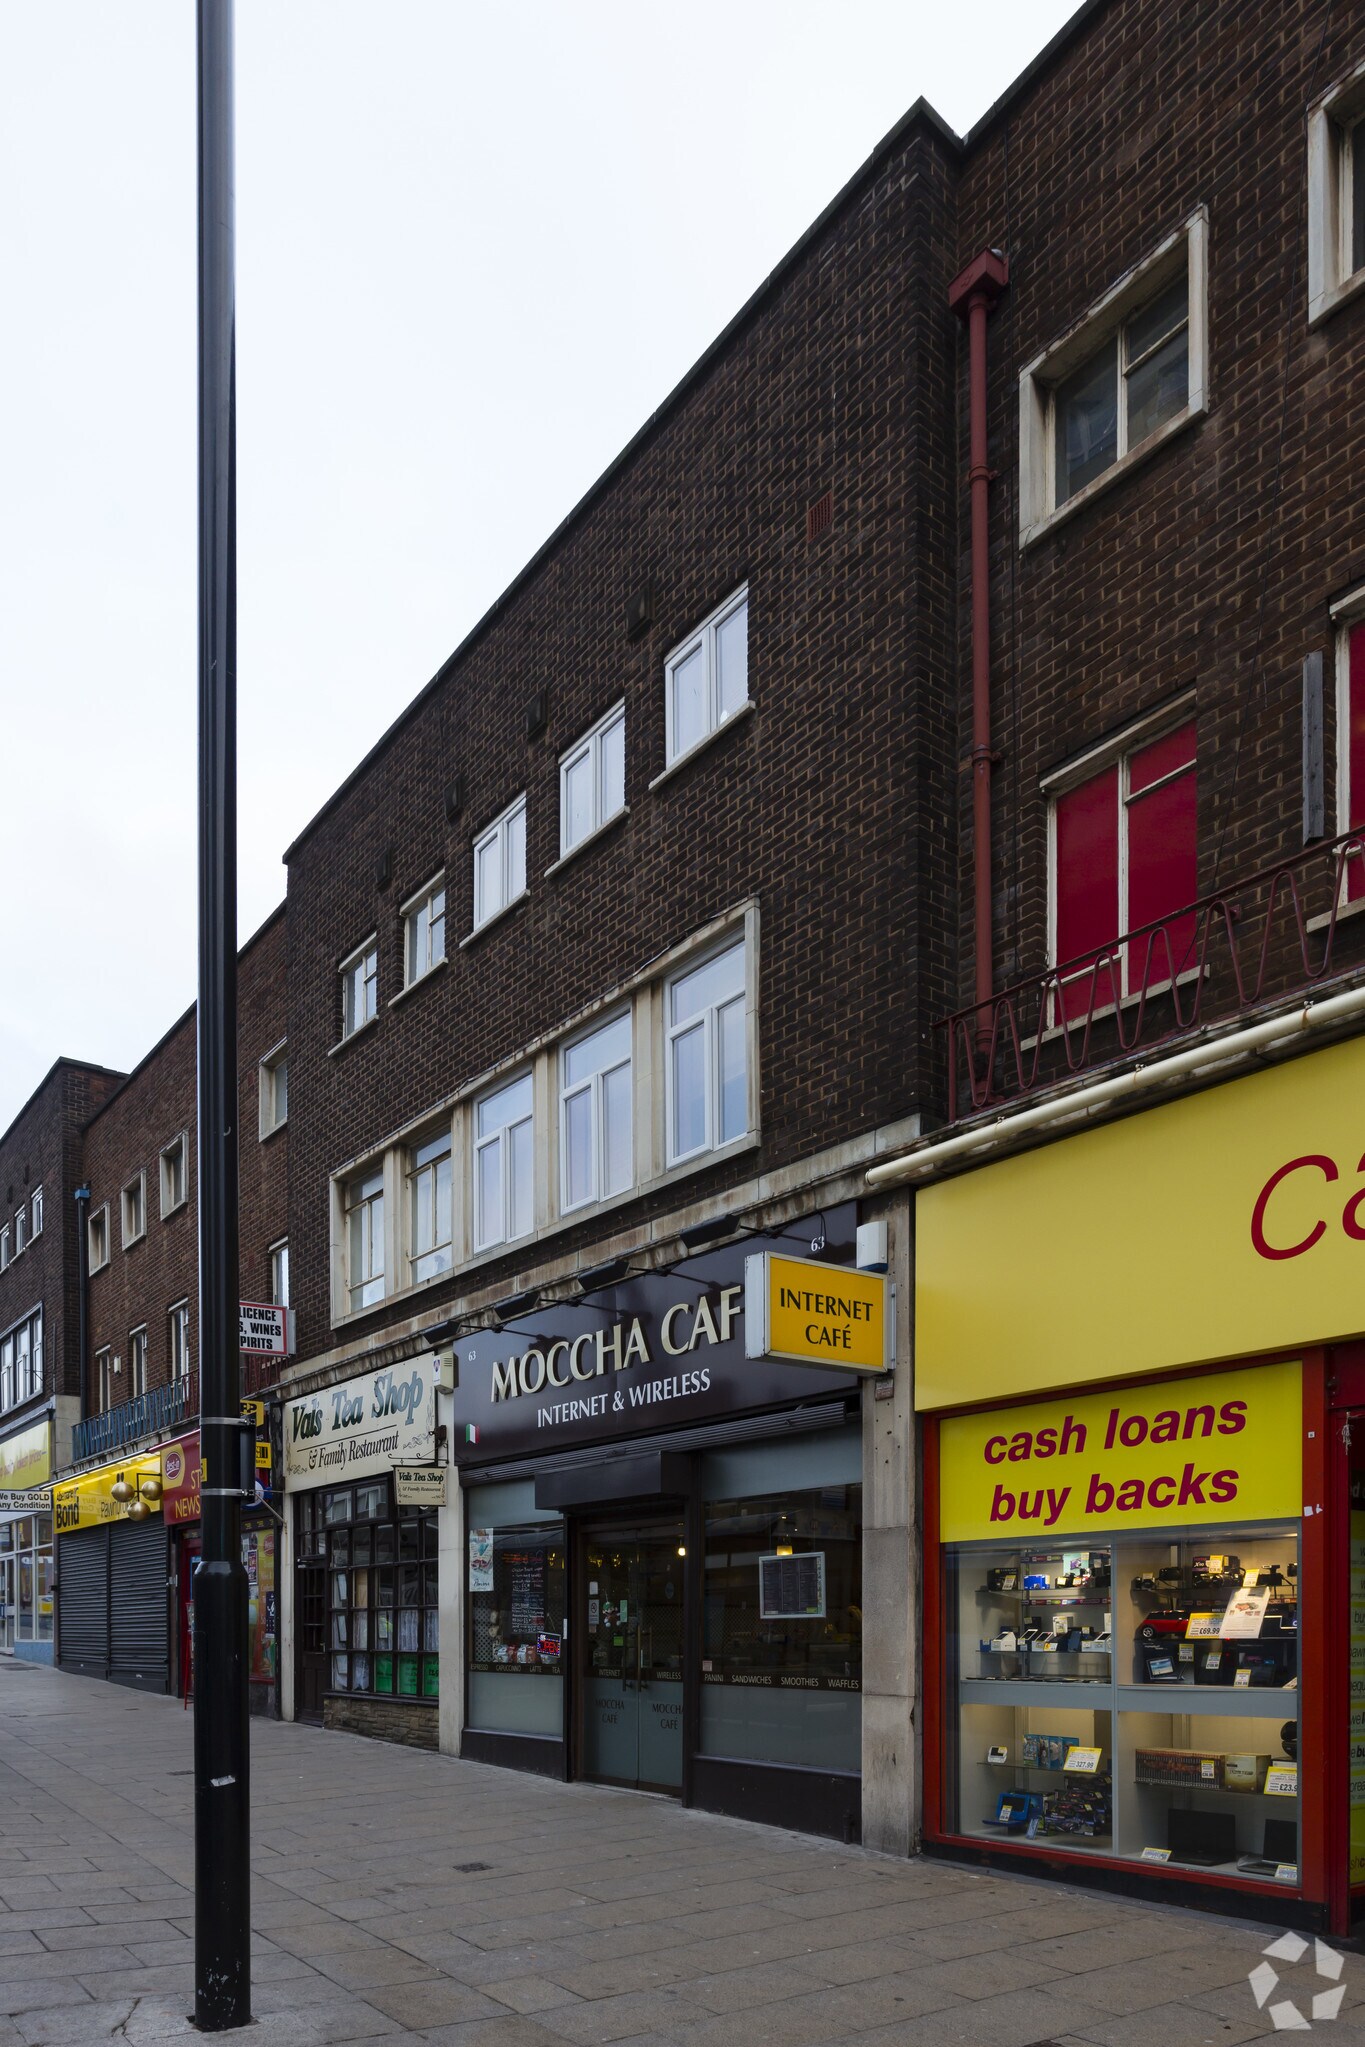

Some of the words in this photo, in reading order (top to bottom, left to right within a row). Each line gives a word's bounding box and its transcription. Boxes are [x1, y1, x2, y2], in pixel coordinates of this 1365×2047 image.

[811, 1236, 825, 1251] 63
[780, 1288, 873, 1321] INTERNET
[250, 1322, 282, 1336] WINES
[240, 1336, 273, 1350] PIRITS
[805, 1324, 851, 1349] CAFÉ
[491, 1317, 650, 1402] MOCCHA
[661, 1286, 742, 1356] CAF
[468, 1350, 477, 1361] 63
[332, 1390, 364, 1431] Tea
[371, 1371, 424, 1425] Shop
[537, 1393, 609, 1428] INTERNET
[612, 1390, 625, 1411] &
[628, 1368, 711, 1407] WIRELESS
[984, 1416, 1087, 1464] cash
[1104, 1400, 1248, 1450] loans
[308, 1450, 318, 1470] &
[318, 1441, 346, 1470] Family
[348, 1430, 400, 1461] Restaurant
[413, 1472, 426, 1481] Tea
[427, 1472, 444, 1484] Shop
[11, 1493, 25, 1502] Buy
[27, 1493, 50, 1501] GOLD
[990, 1484, 1072, 1525] buy
[1085, 1463, 1239, 1514] backs
[14, 1501, 50, 1510] Condition
[57, 1499, 79, 1528] Bond
[1199, 1627, 1220, 1635] £69.99
[470, 1663, 489, 1671] ESPRESSO
[529, 1665, 542, 1673] LATTE
[552, 1666, 561, 1674] TEA
[599, 1669, 621, 1678] INTERNET
[656, 1671, 682, 1680] WIRELESS
[704, 1673, 724, 1682] PANINI
[731, 1674, 772, 1685] SANDWICHES
[780, 1676, 819, 1687] SMOOTHIES
[828, 1679, 860, 1689] WAFFLES
[596, 1699, 625, 1710] MOCCHA
[602, 1712, 618, 1724] CAFÉ
[661, 1716, 678, 1730] CAFÉ
[1280, 1783, 1297, 1793] £23.9
